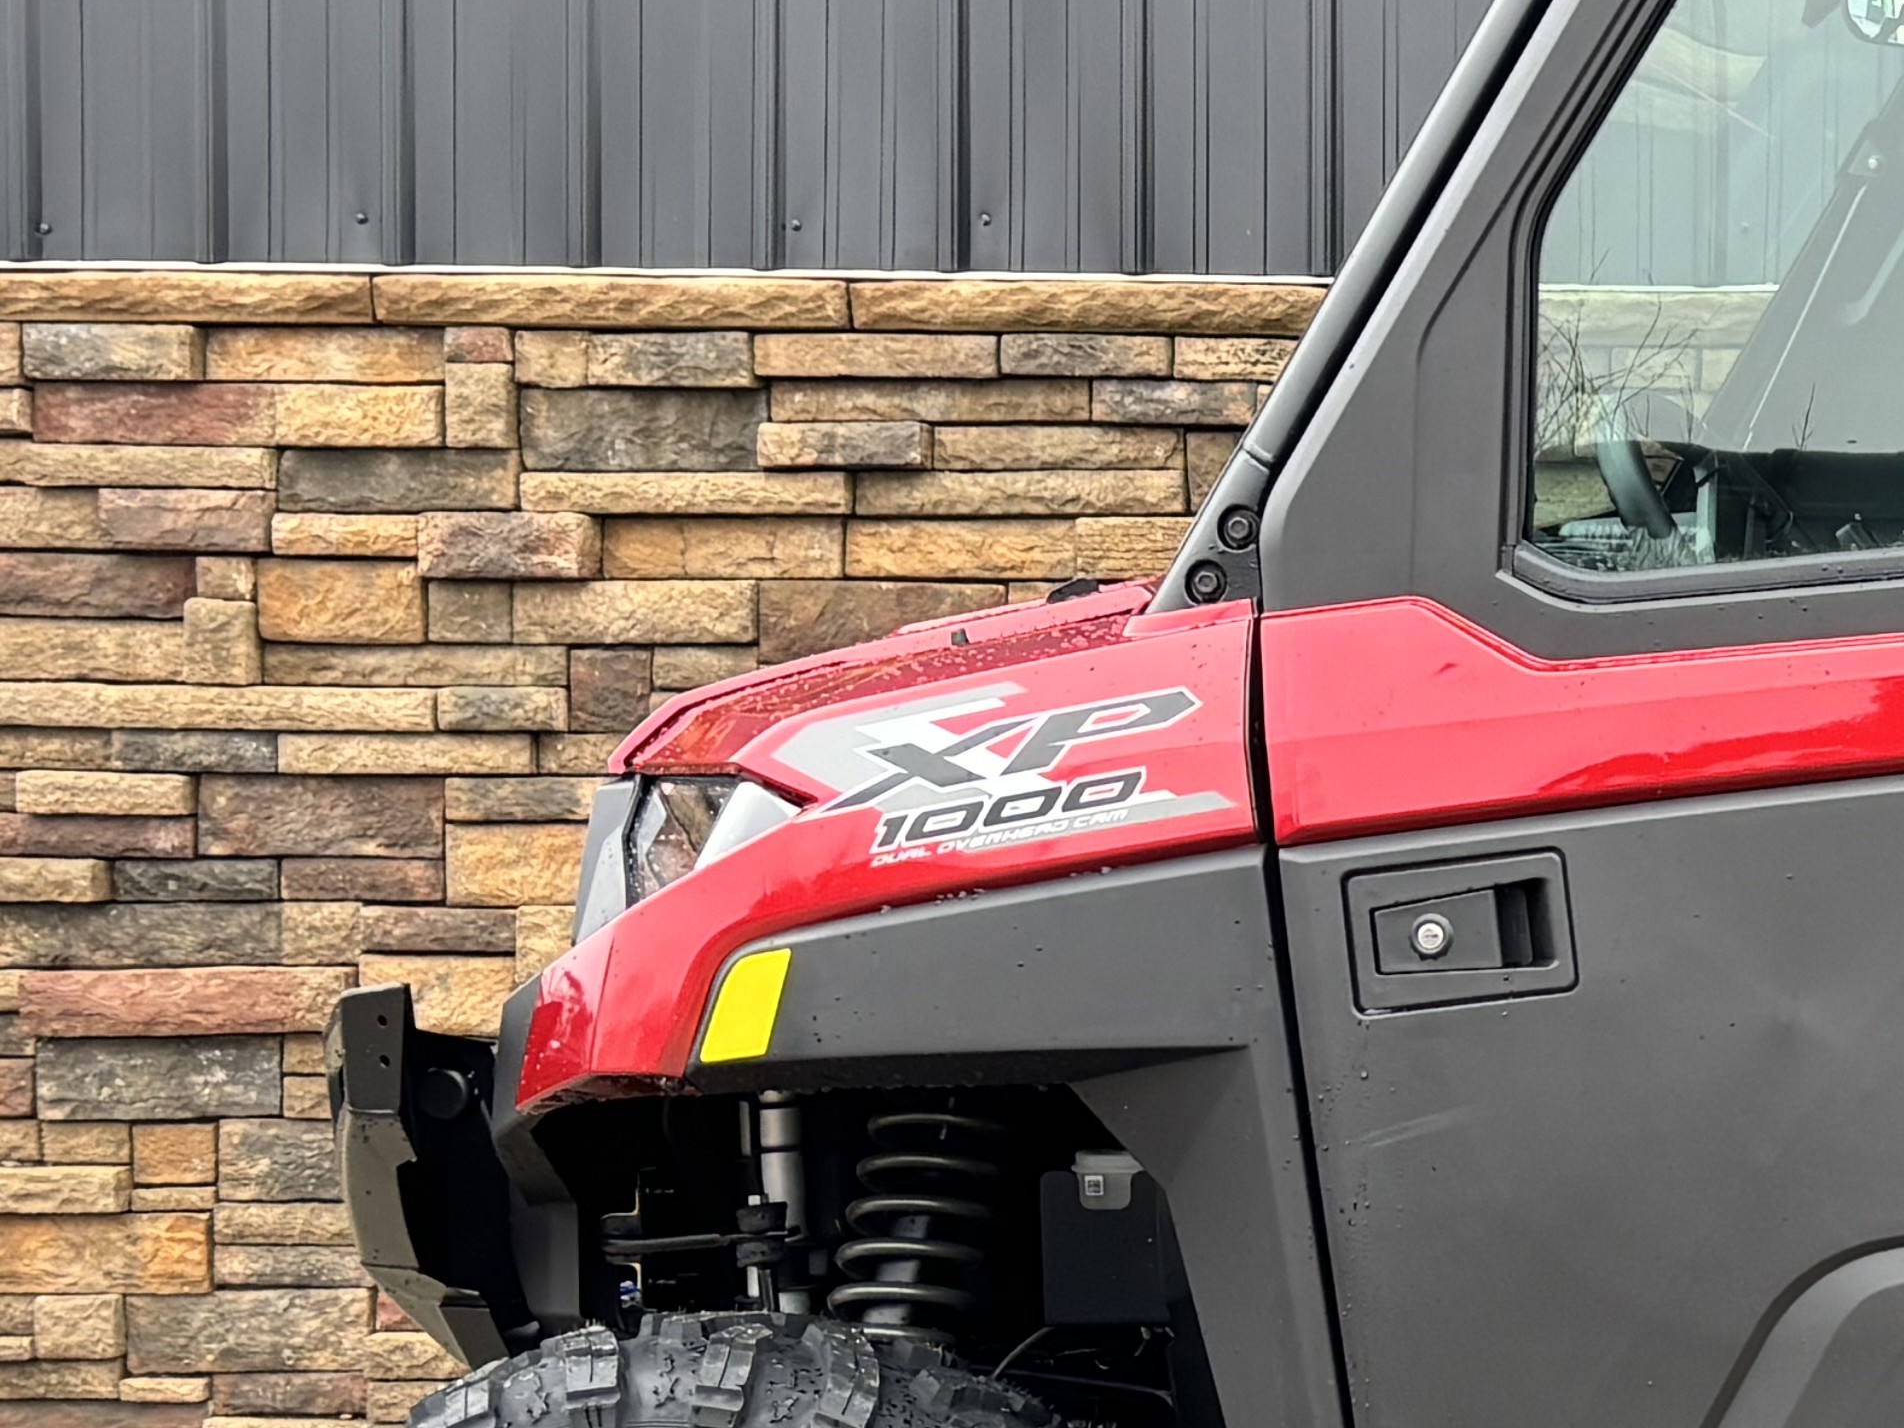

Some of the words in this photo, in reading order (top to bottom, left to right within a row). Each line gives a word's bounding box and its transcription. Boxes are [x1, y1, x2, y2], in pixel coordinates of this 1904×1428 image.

[814, 688, 1199, 813] XP
[870, 766, 1147, 853] 1000
[870, 847, 932, 868] DUAL
[937, 820, 1068, 855] OVERHEAD
[1073, 809, 1129, 829] CAM
